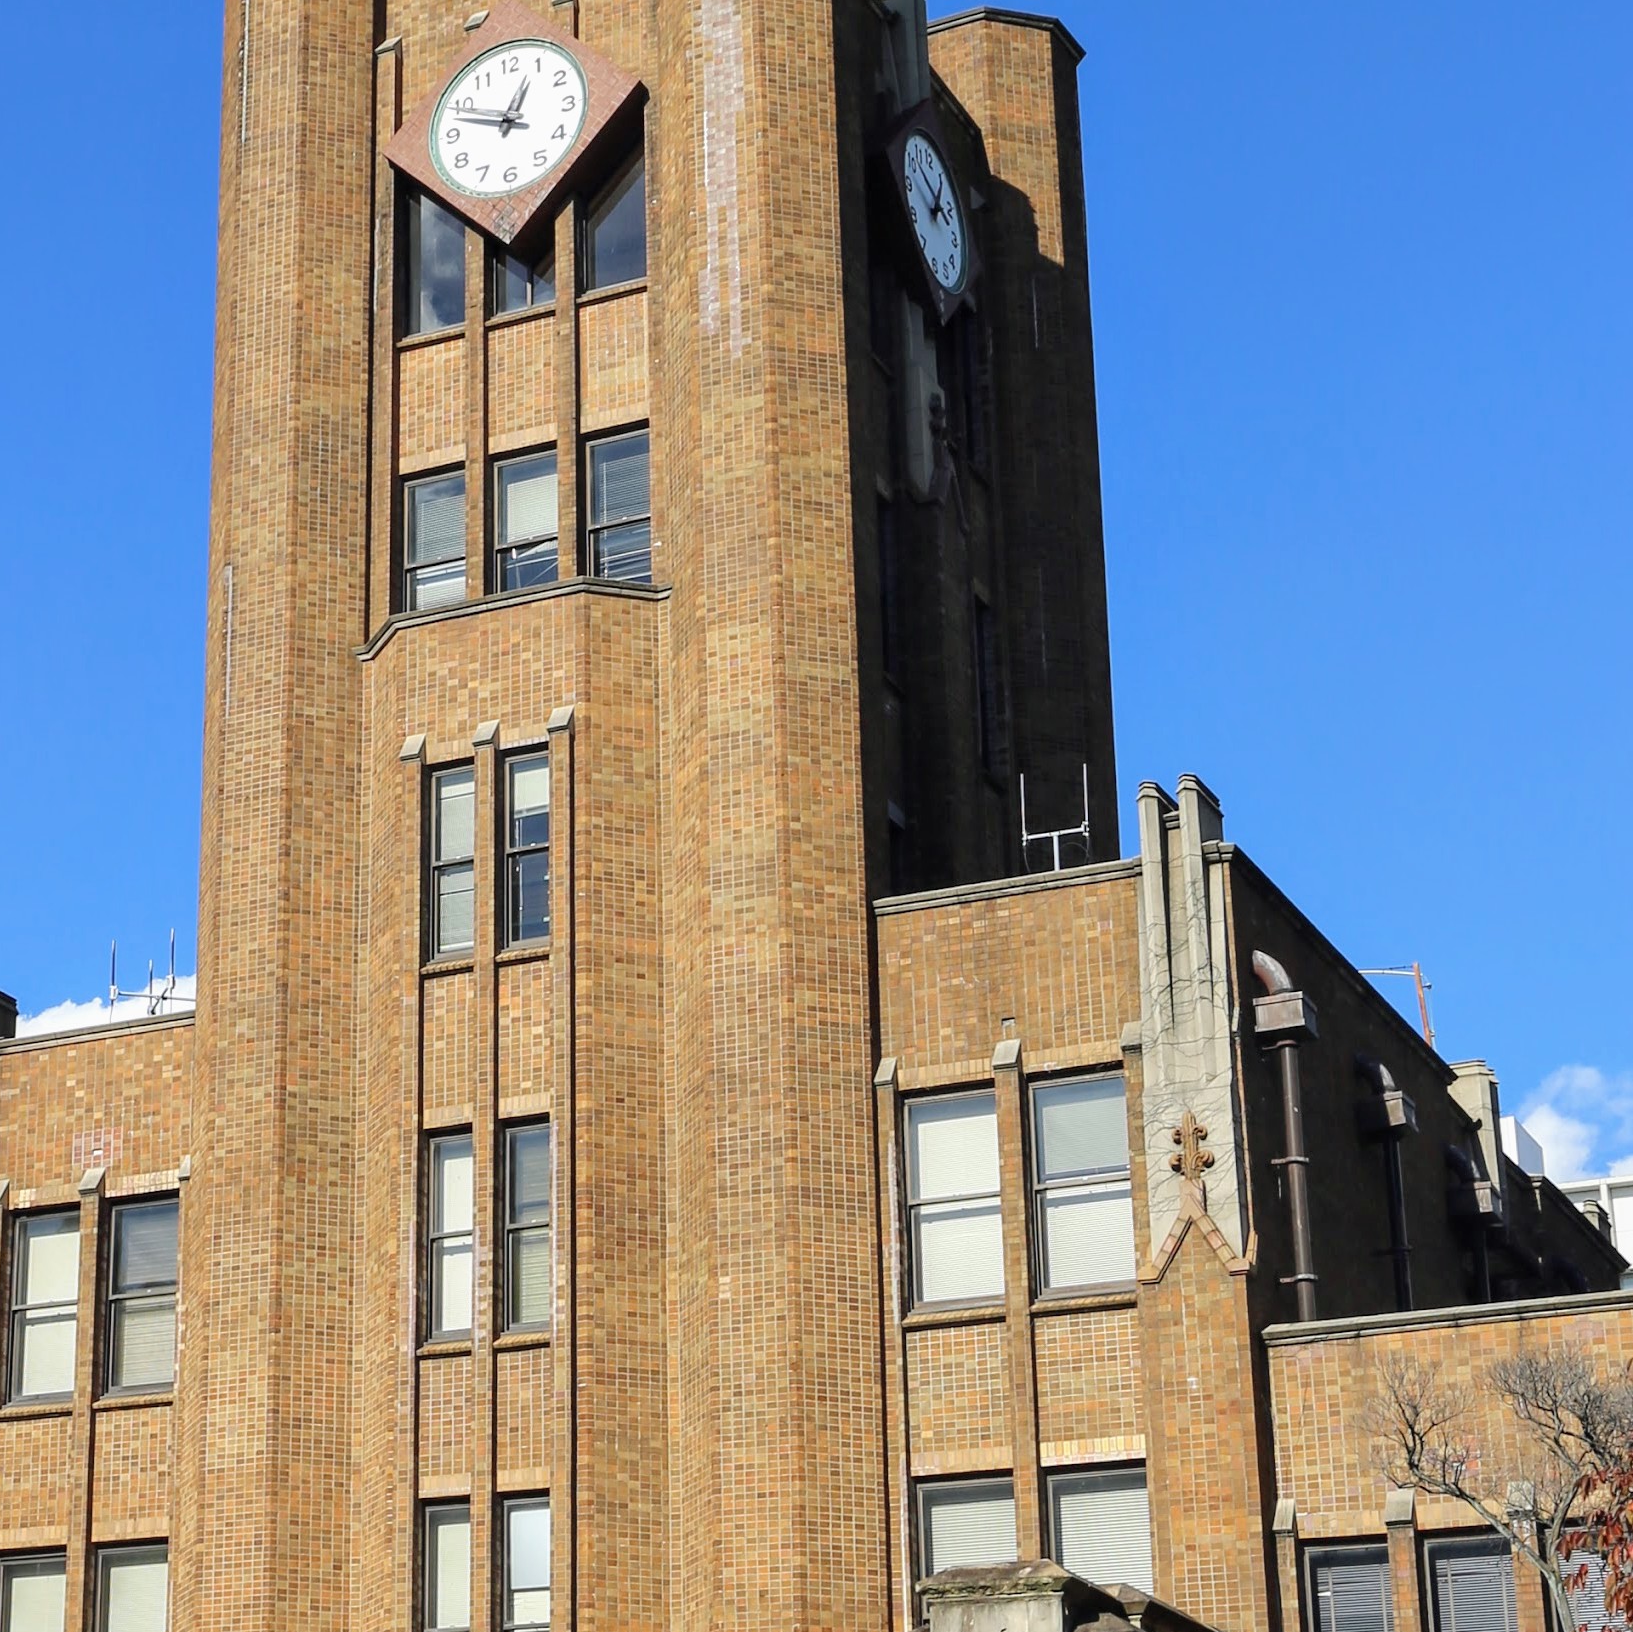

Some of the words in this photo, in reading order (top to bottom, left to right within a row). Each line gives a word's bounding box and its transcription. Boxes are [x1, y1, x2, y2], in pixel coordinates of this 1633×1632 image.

[501, 57, 519, 74] 12
[535, 57, 541, 73] 1
[475, 72, 490, 90] 11
[553, 70, 567, 87] 2
[455, 97, 474, 115] 10
[561, 95, 576, 112] 3
[446, 128, 460, 144] 9
[551, 124, 567, 140] 4
[454, 152, 469, 168] 8
[533, 149, 548, 167] 5
[907, 152, 917, 173] 10
[925, 148, 933, 170] 12
[475, 164, 490, 183] 7
[503, 167, 518, 183] 6
[946, 200, 954, 219] 2
[951, 231, 959, 249] 3
[948, 253, 956, 270] 4
[942, 261, 949, 280] 5
